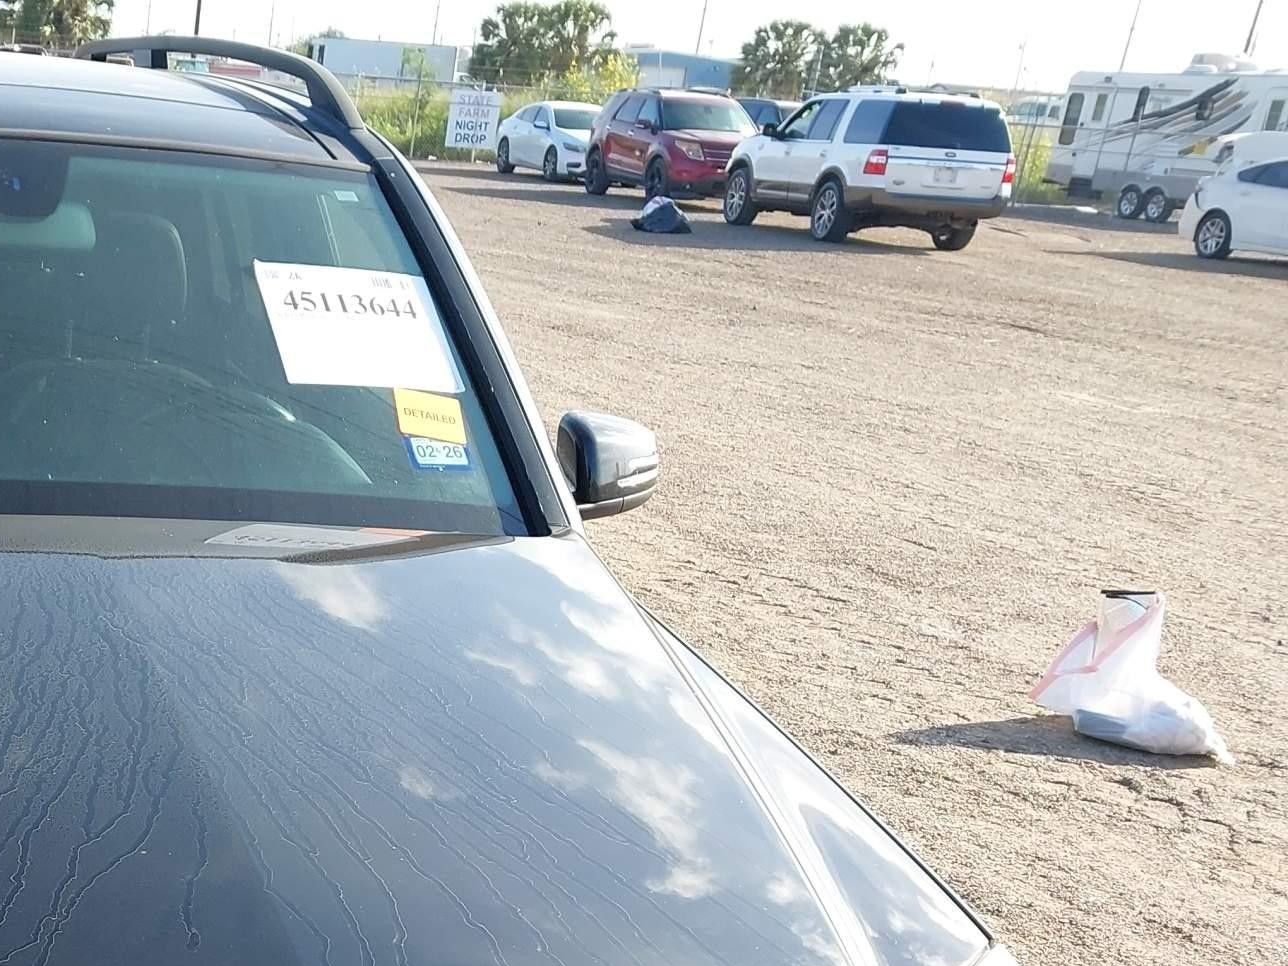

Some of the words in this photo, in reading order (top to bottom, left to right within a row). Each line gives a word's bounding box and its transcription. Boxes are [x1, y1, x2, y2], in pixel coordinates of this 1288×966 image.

[459, 95, 492, 106] STATE
[458, 107, 490, 119] FARM
[455, 120, 490, 132] NIGHT
[454, 132, 487, 145] DROP
[283, 289, 418, 319] 45113644
[403, 407, 456, 425] DETAILED
